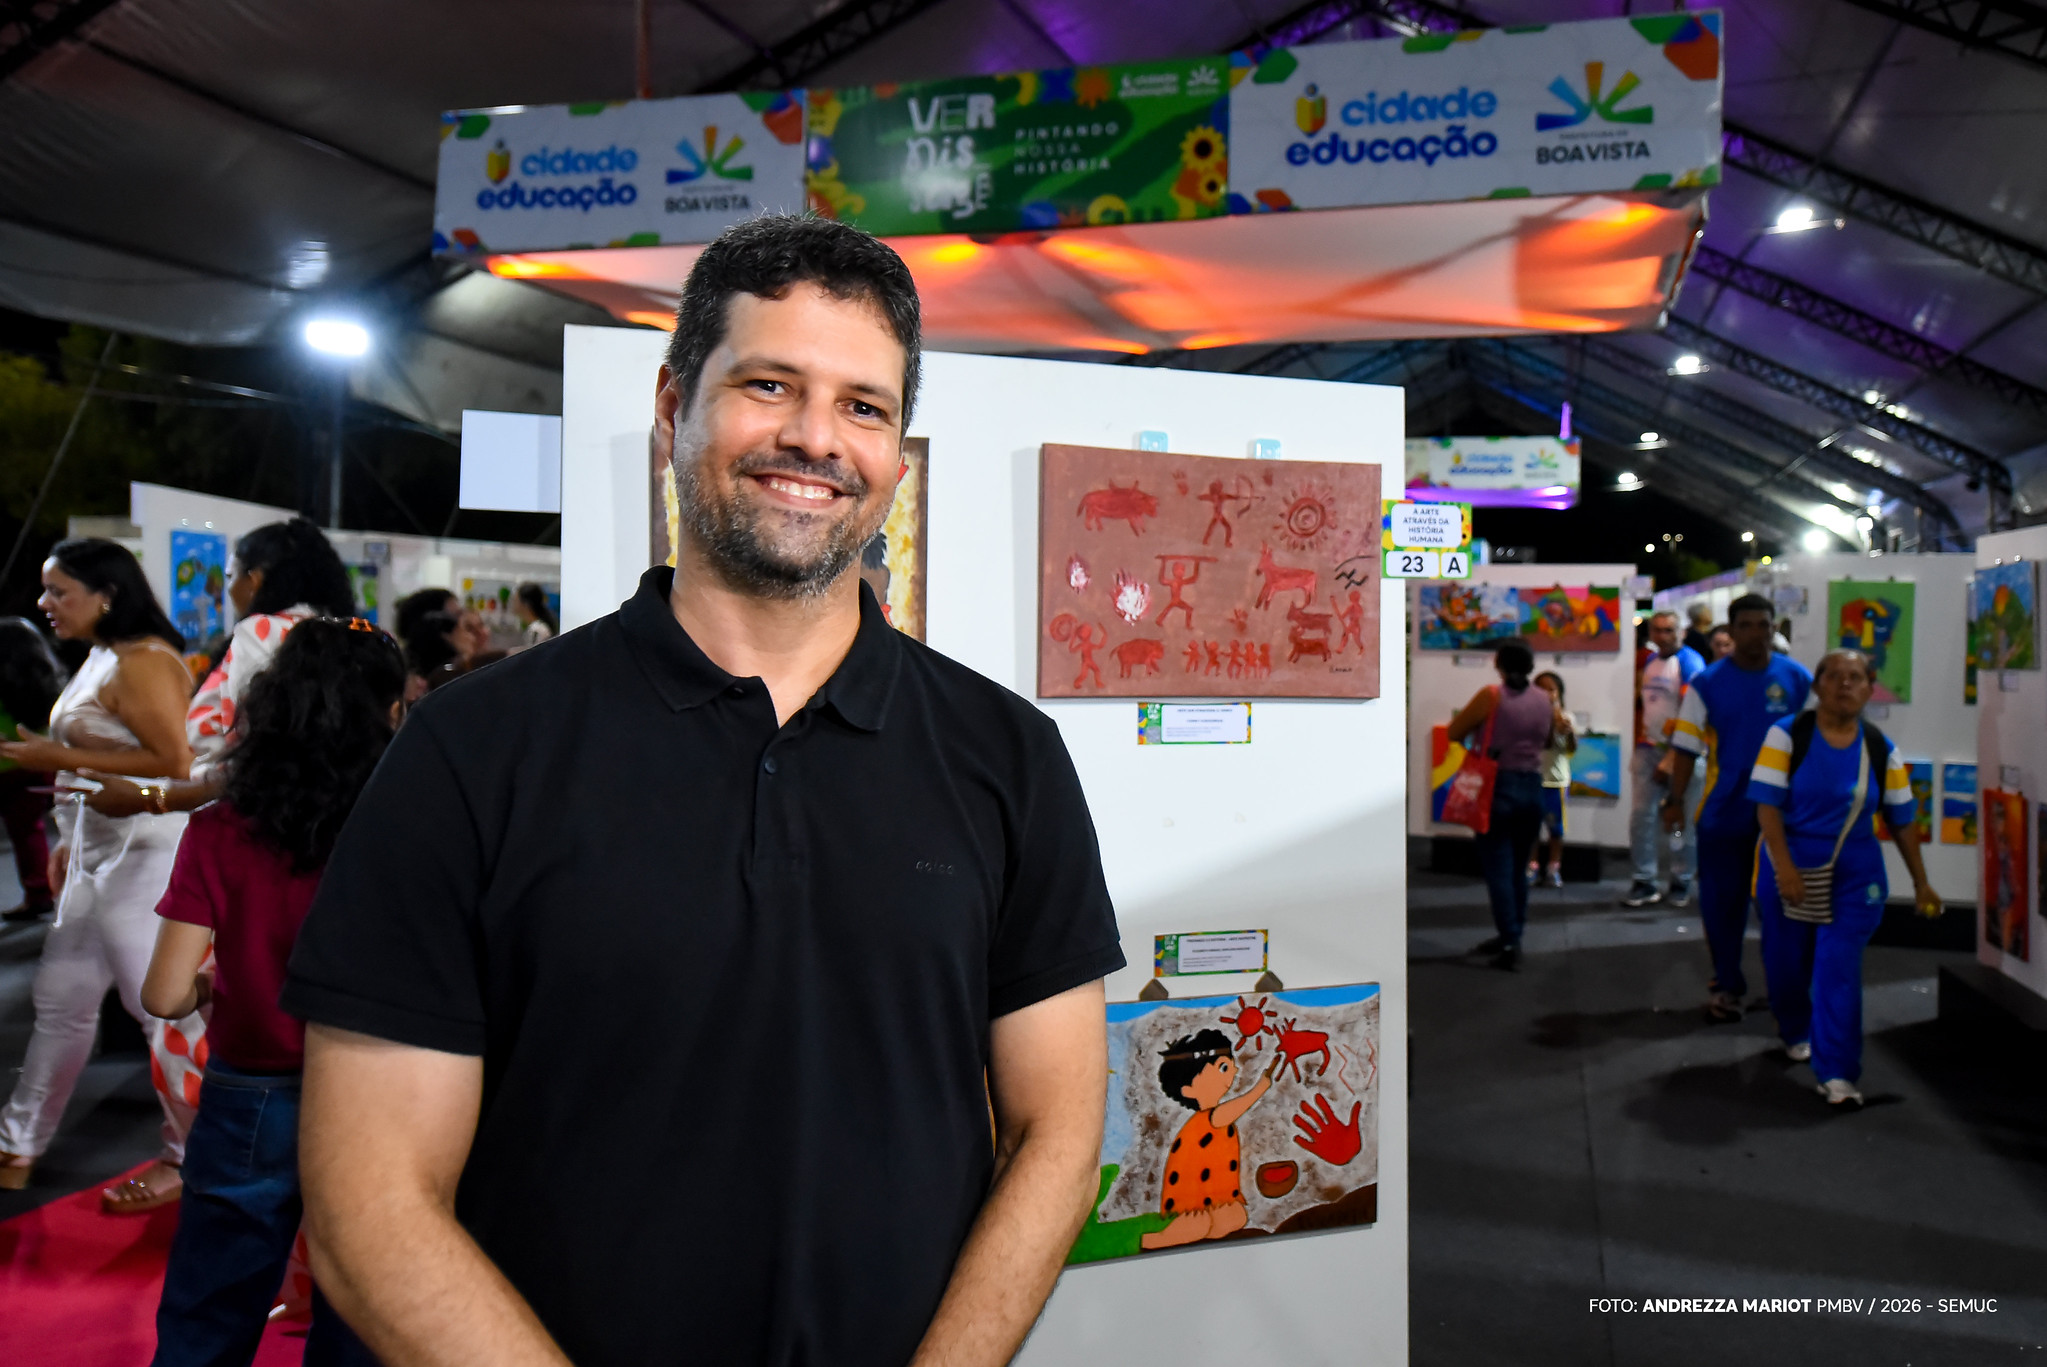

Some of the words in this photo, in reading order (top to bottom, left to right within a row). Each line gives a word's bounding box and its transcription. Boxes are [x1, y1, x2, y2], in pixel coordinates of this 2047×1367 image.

[907, 92, 997, 133] VER
[1341, 85, 1498, 127] cidade
[1014, 121, 1120, 140] PINTANDO
[1286, 124, 1498, 166] educação
[521, 144, 639, 176] cidade
[1014, 142, 1081, 158] NOSSA
[476, 178, 638, 213] educação
[1408, 525, 1444, 534] HISTÓRIA
[1402, 555, 1424, 573] 23
[1447, 556, 1462, 574] A
